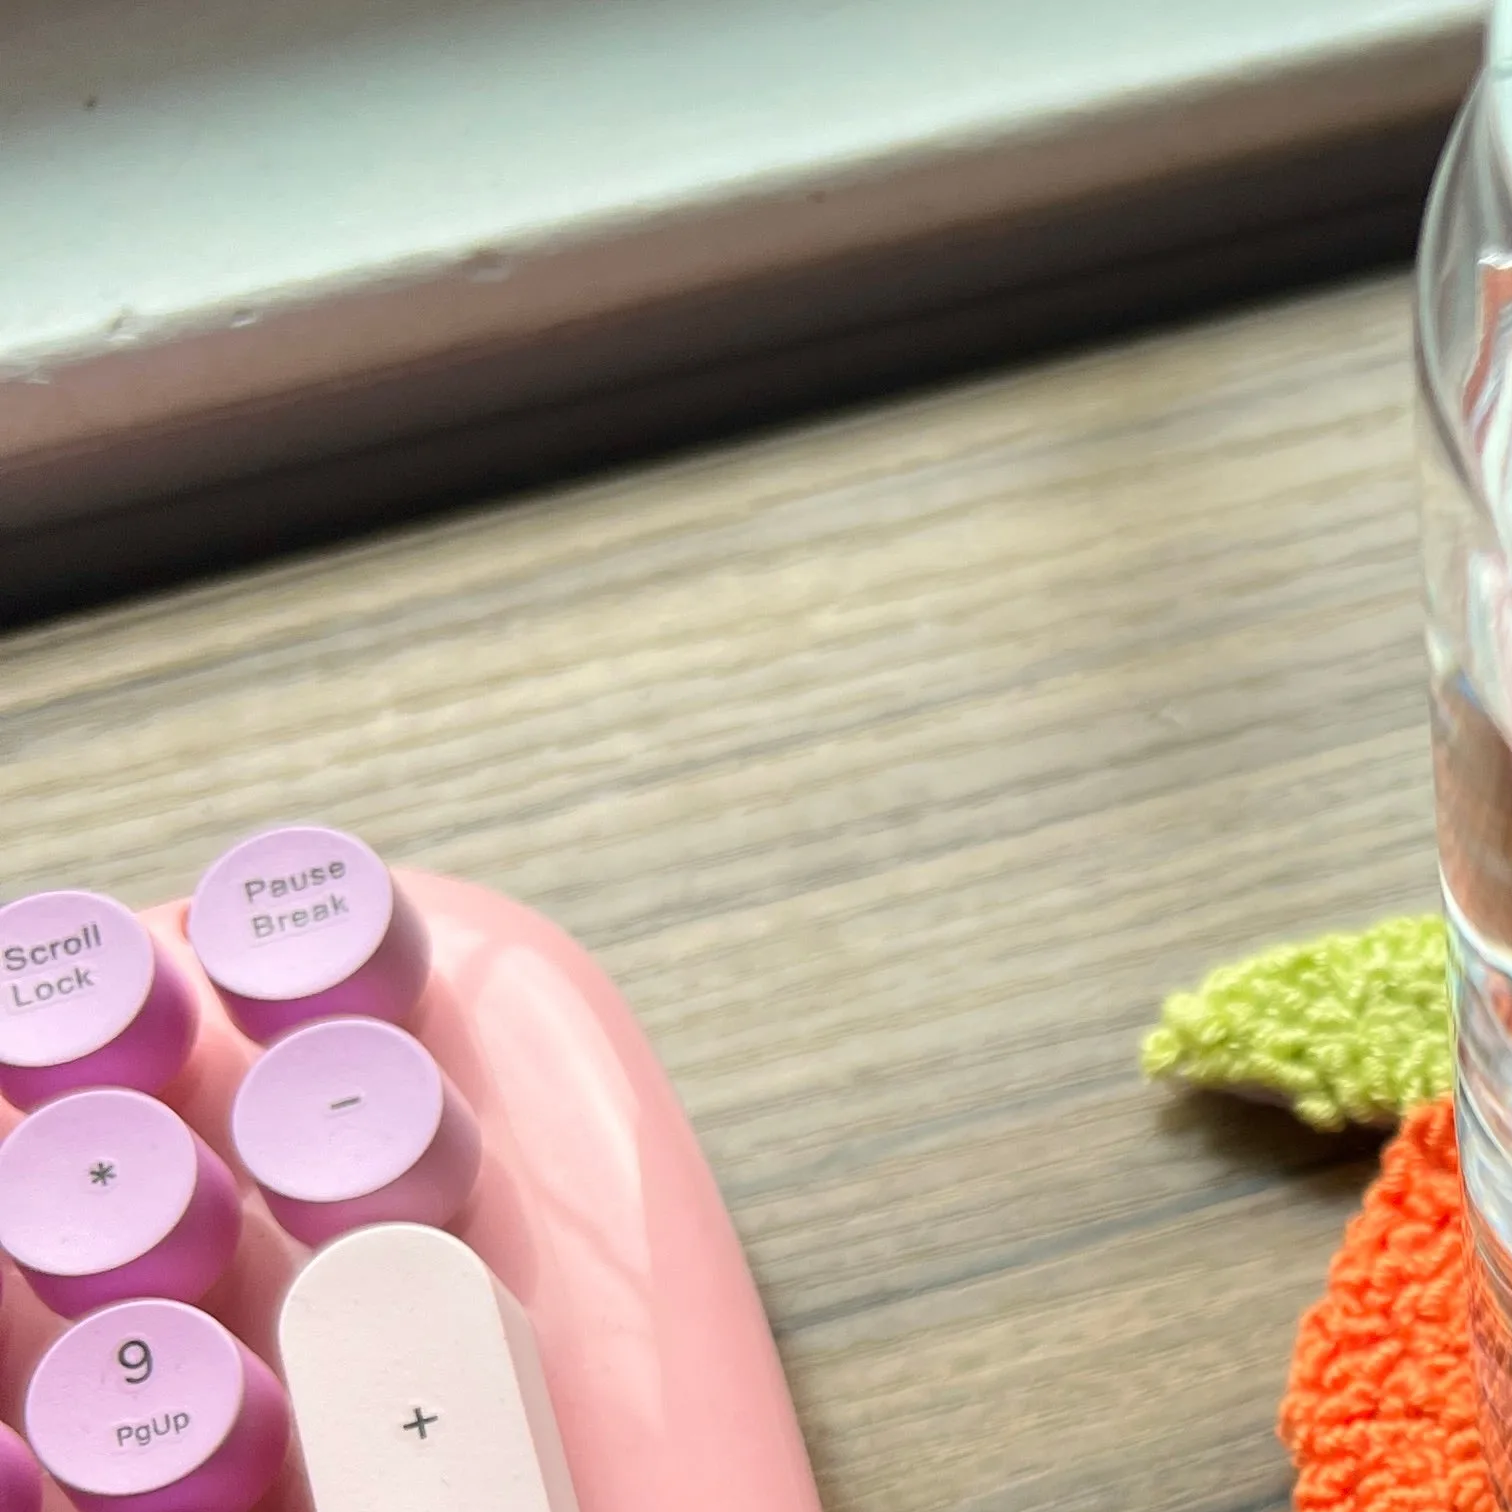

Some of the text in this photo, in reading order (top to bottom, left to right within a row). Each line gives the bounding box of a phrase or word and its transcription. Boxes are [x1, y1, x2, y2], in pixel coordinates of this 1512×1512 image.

[244, 859, 347, 904] Pause
[251, 894, 350, 939] Break
[3, 923, 102, 972] Scroll
[11, 964, 95, 1007] Lock
[117, 1339, 154, 1385] 9
[116, 1410, 191, 1447] PgUp
